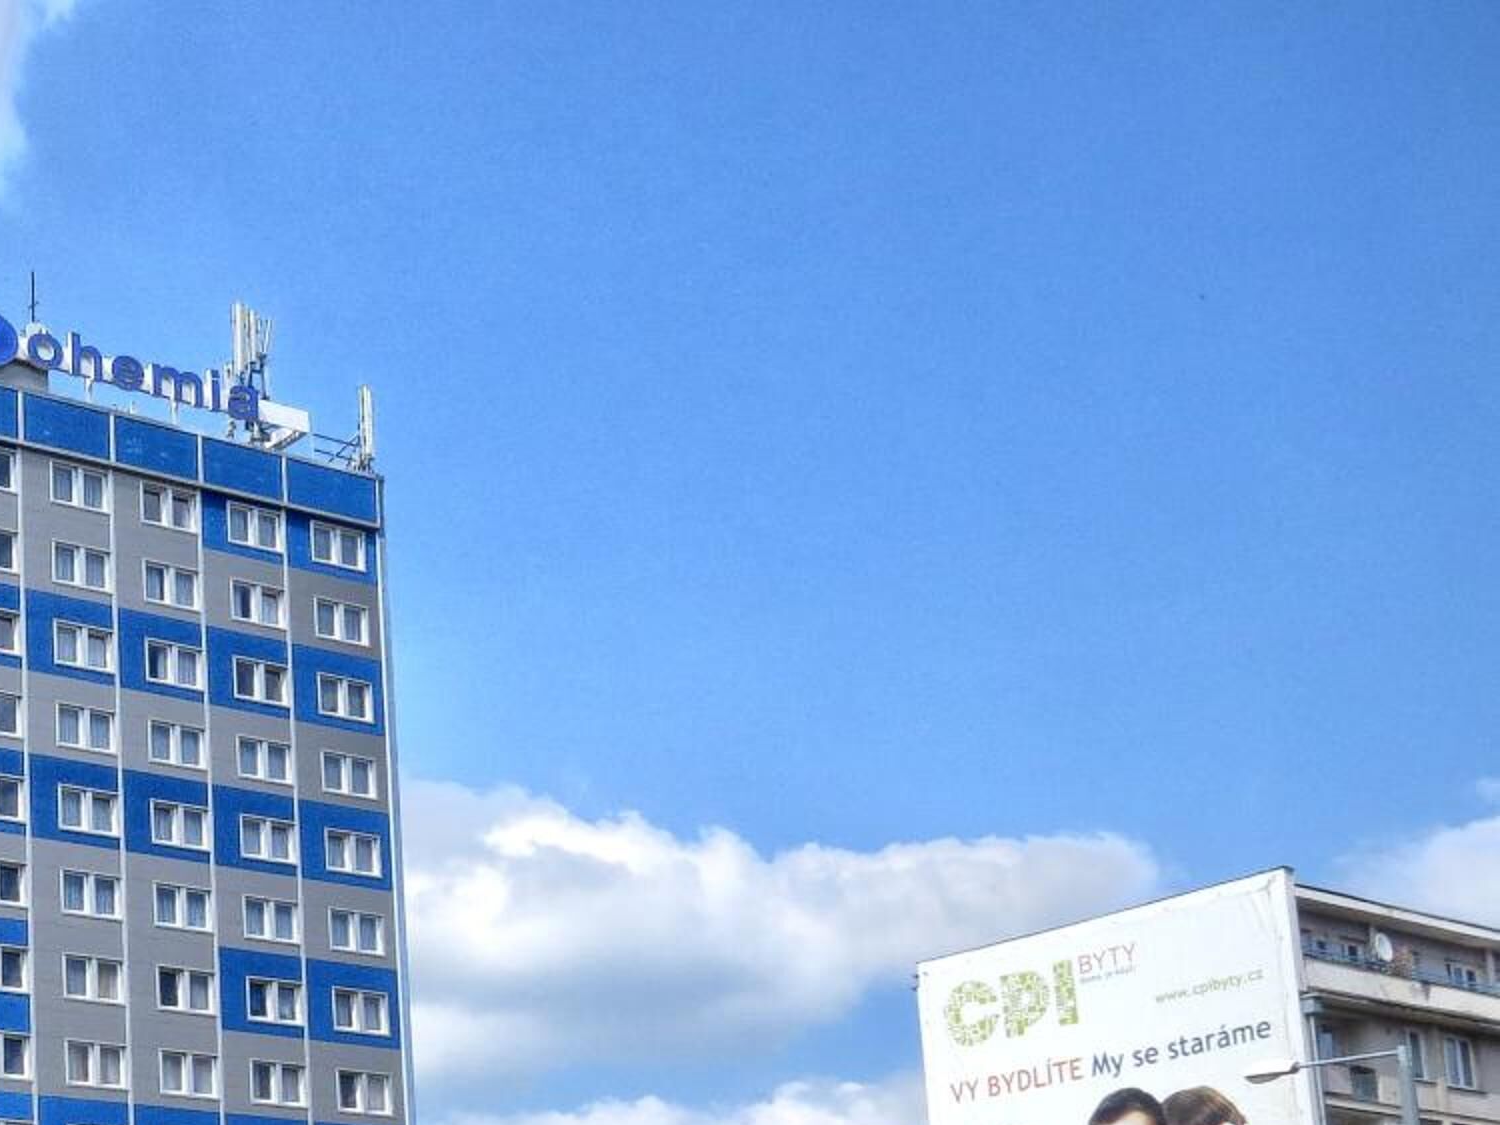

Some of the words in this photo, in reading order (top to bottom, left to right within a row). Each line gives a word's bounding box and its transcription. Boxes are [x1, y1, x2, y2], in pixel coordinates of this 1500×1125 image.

[1077, 943, 1137, 975] BYTY
[1155, 968, 1265, 1003] www.cpibyty.cz
[949, 1079, 979, 1103] VY
[987, 1057, 1085, 1096] BYDLÍTE
[1090, 1050, 1125, 1079] My
[1132, 1048, 1160, 1068] se
[1167, 1020, 1272, 1061] staráme
